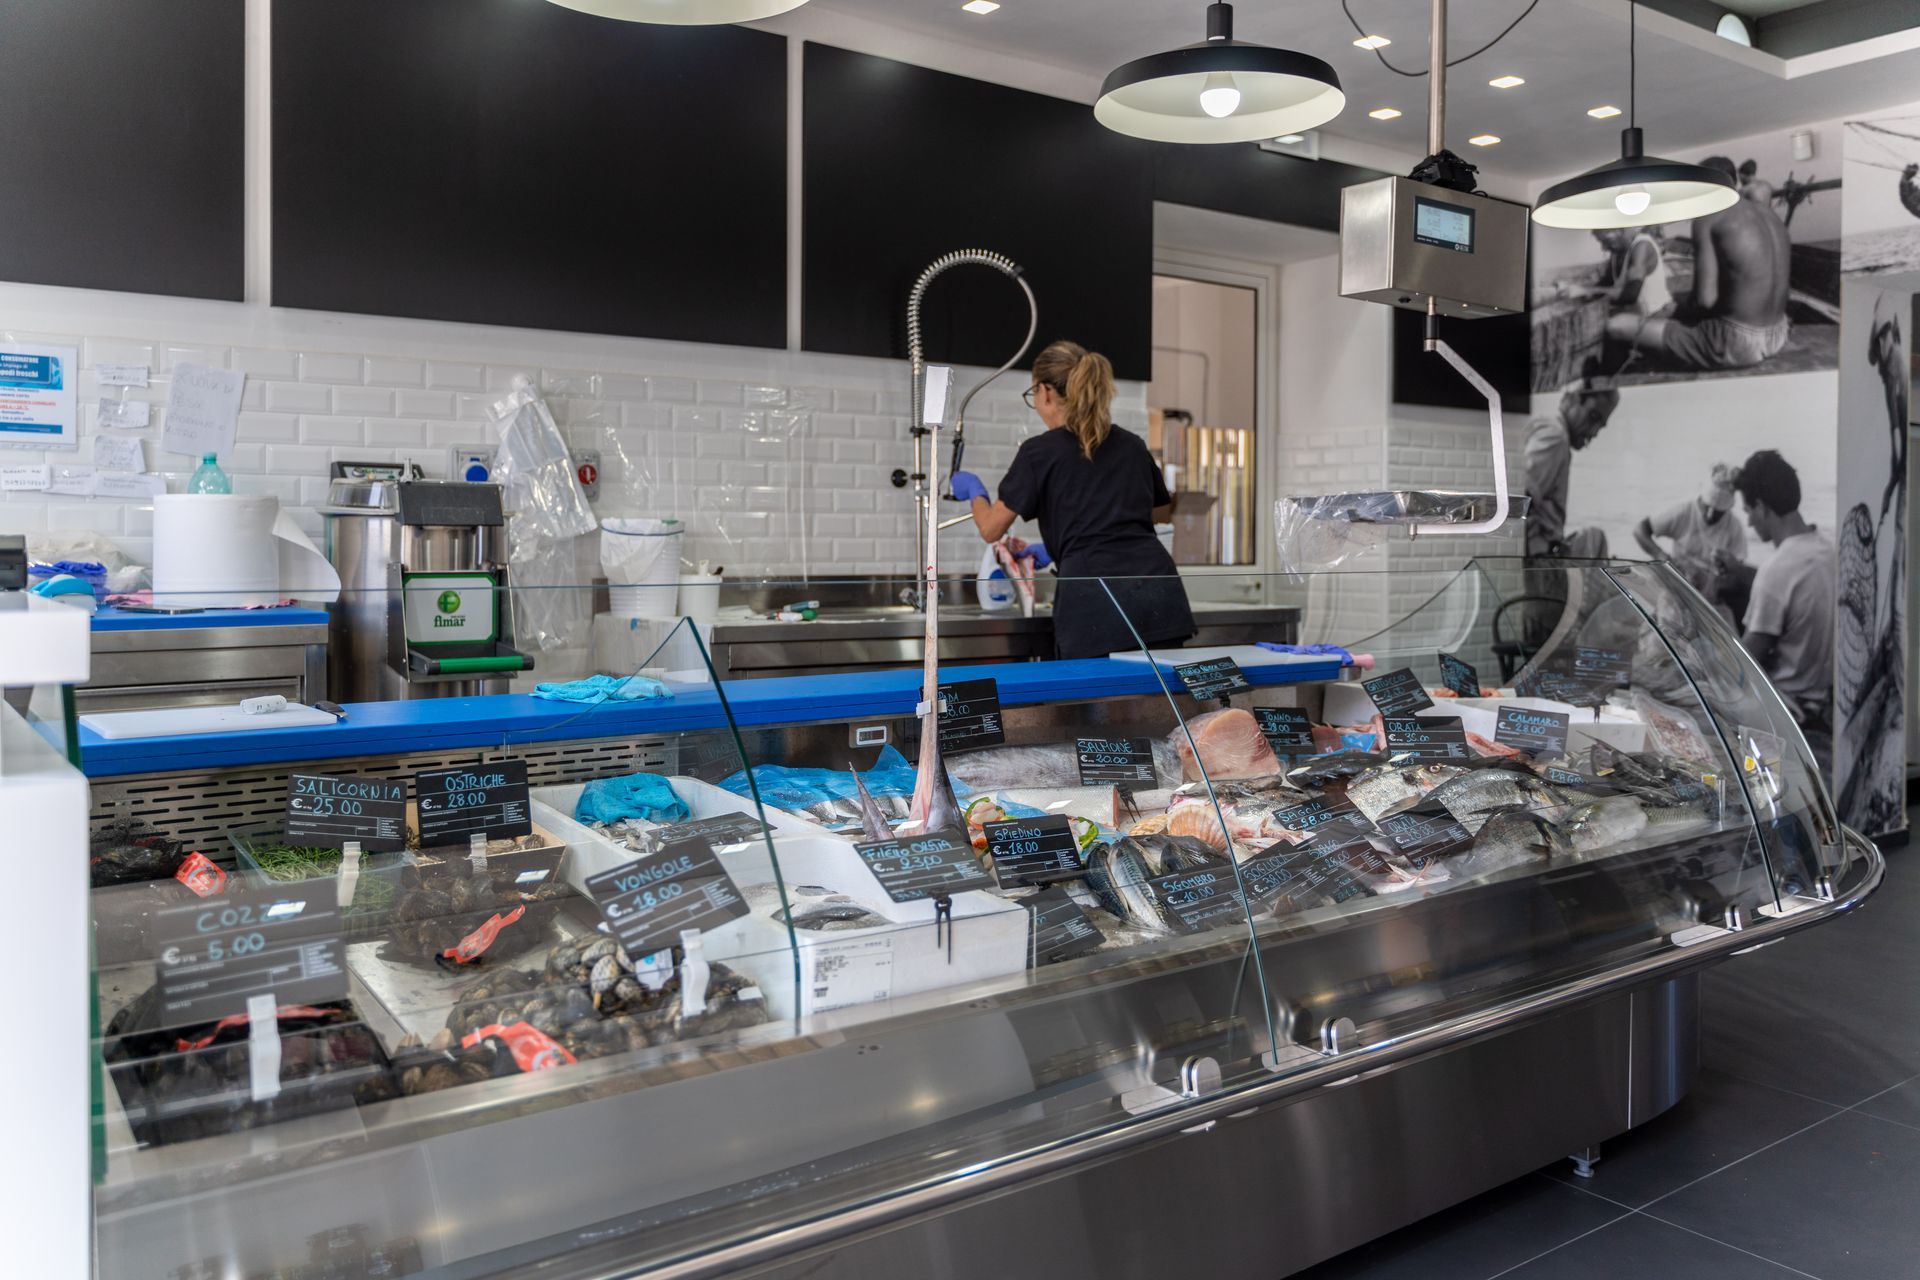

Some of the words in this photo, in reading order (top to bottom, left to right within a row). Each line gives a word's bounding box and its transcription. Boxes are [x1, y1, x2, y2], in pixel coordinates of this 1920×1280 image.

[433, 615, 466, 627] fimar
[1263, 712, 1291, 721] TONNO
[1508, 713, 1559, 727] CALAMARO
[1389, 722, 1422, 732] ORATA
[1096, 754, 1128, 764] 20.00
[445, 773, 506, 792] OSTRICHE
[313, 796, 362, 815] 25.00
[448, 792, 486, 808] 28.00
[1008, 841, 1039, 855] 18.00
[614, 856, 693, 892] VONGOLE
[1163, 873, 1216, 893] SGOMBRO
[633, 882, 683, 911] 18.00
[207, 933, 265, 961] 5.00
